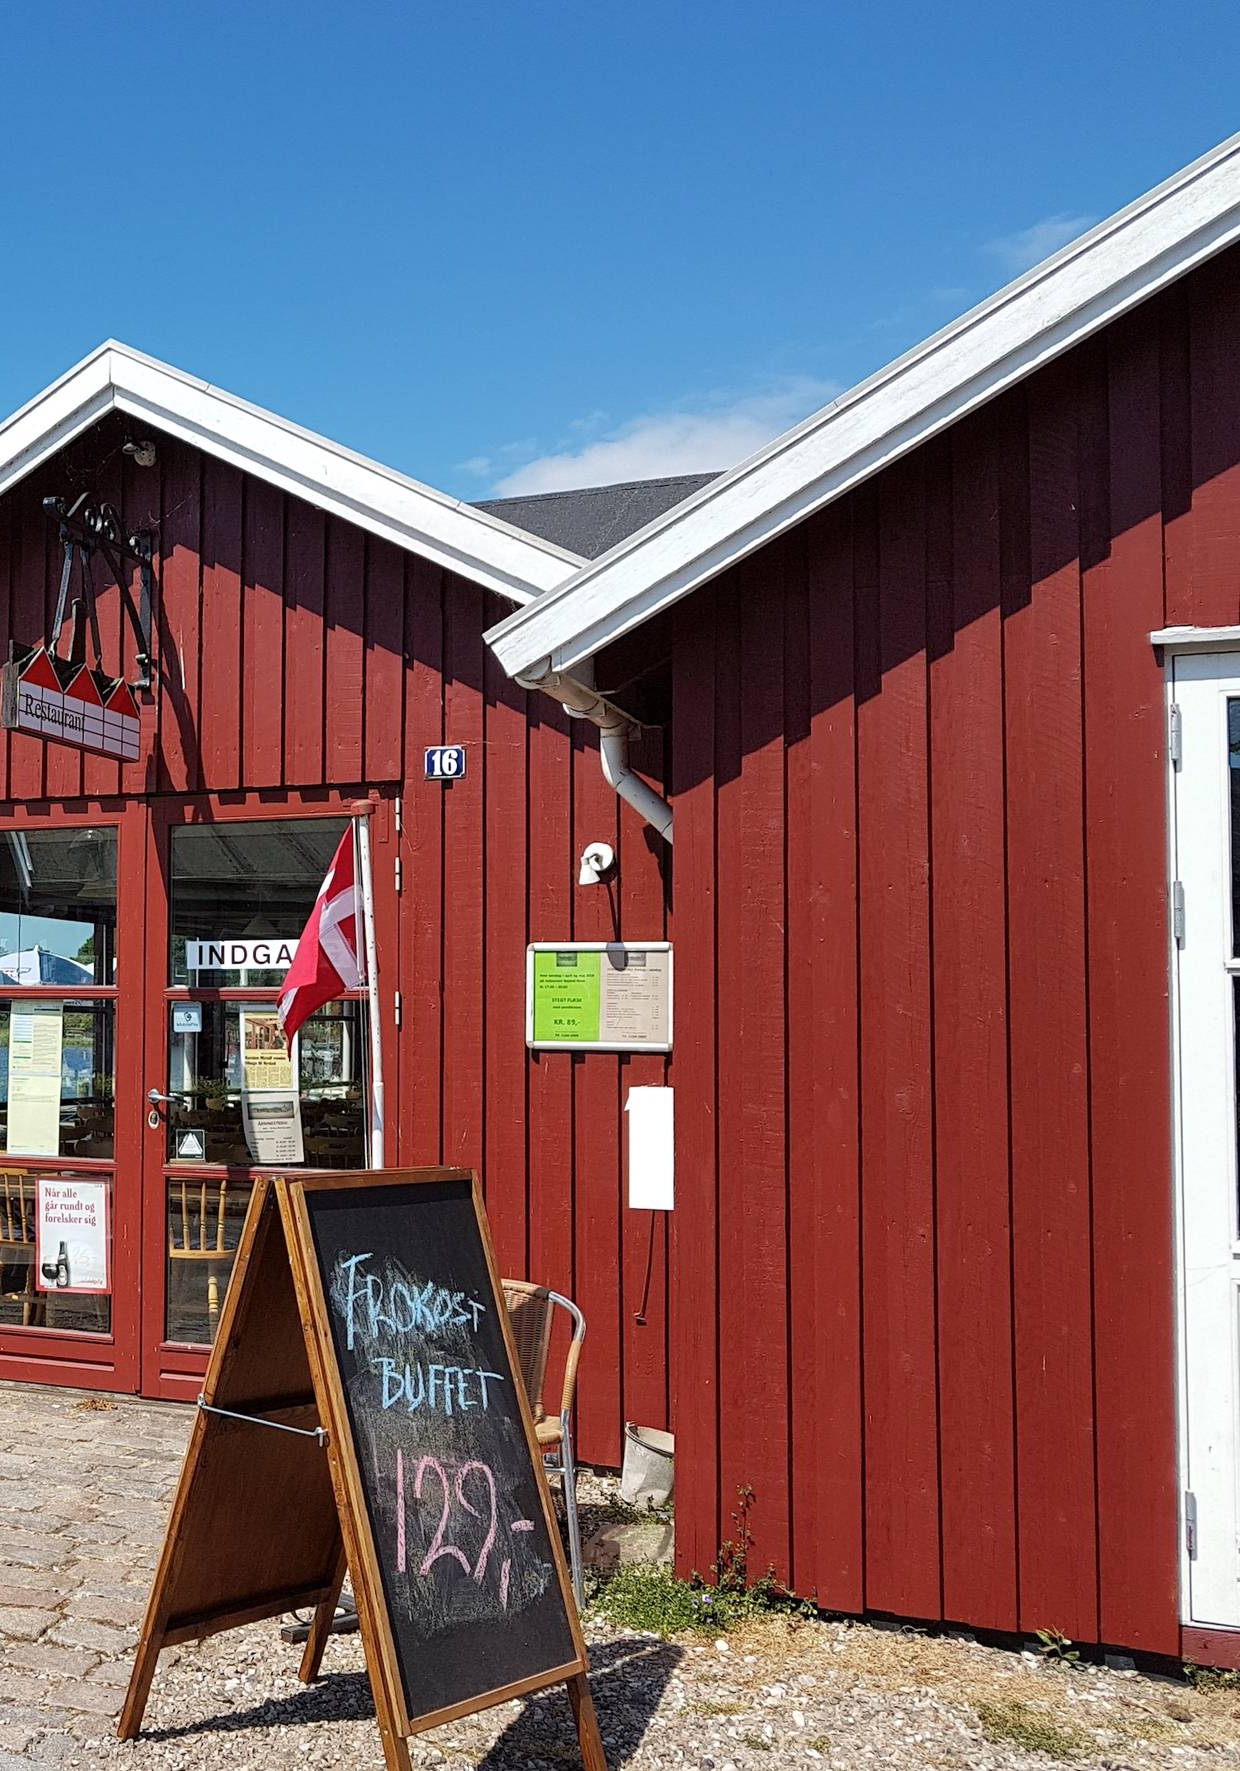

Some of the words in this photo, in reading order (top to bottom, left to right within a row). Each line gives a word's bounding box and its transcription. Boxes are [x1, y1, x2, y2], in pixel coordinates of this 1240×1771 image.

[24, 693, 85, 732] Restaurant
[431, 749, 459, 776] 16
[197, 943, 293, 966] INDGA
[44, 1187, 61, 1198] Når
[62, 1188, 77, 1198] alle
[44, 1200, 59, 1212] går
[60, 1200, 83, 1211] rundt
[84, 1203, 96, 1213] og
[44, 1212, 83, 1224] forelsker
[84, 1214, 97, 1227] sig
[340, 1251, 487, 1351] FROKOST
[371, 1356, 506, 1417] BUFFET
